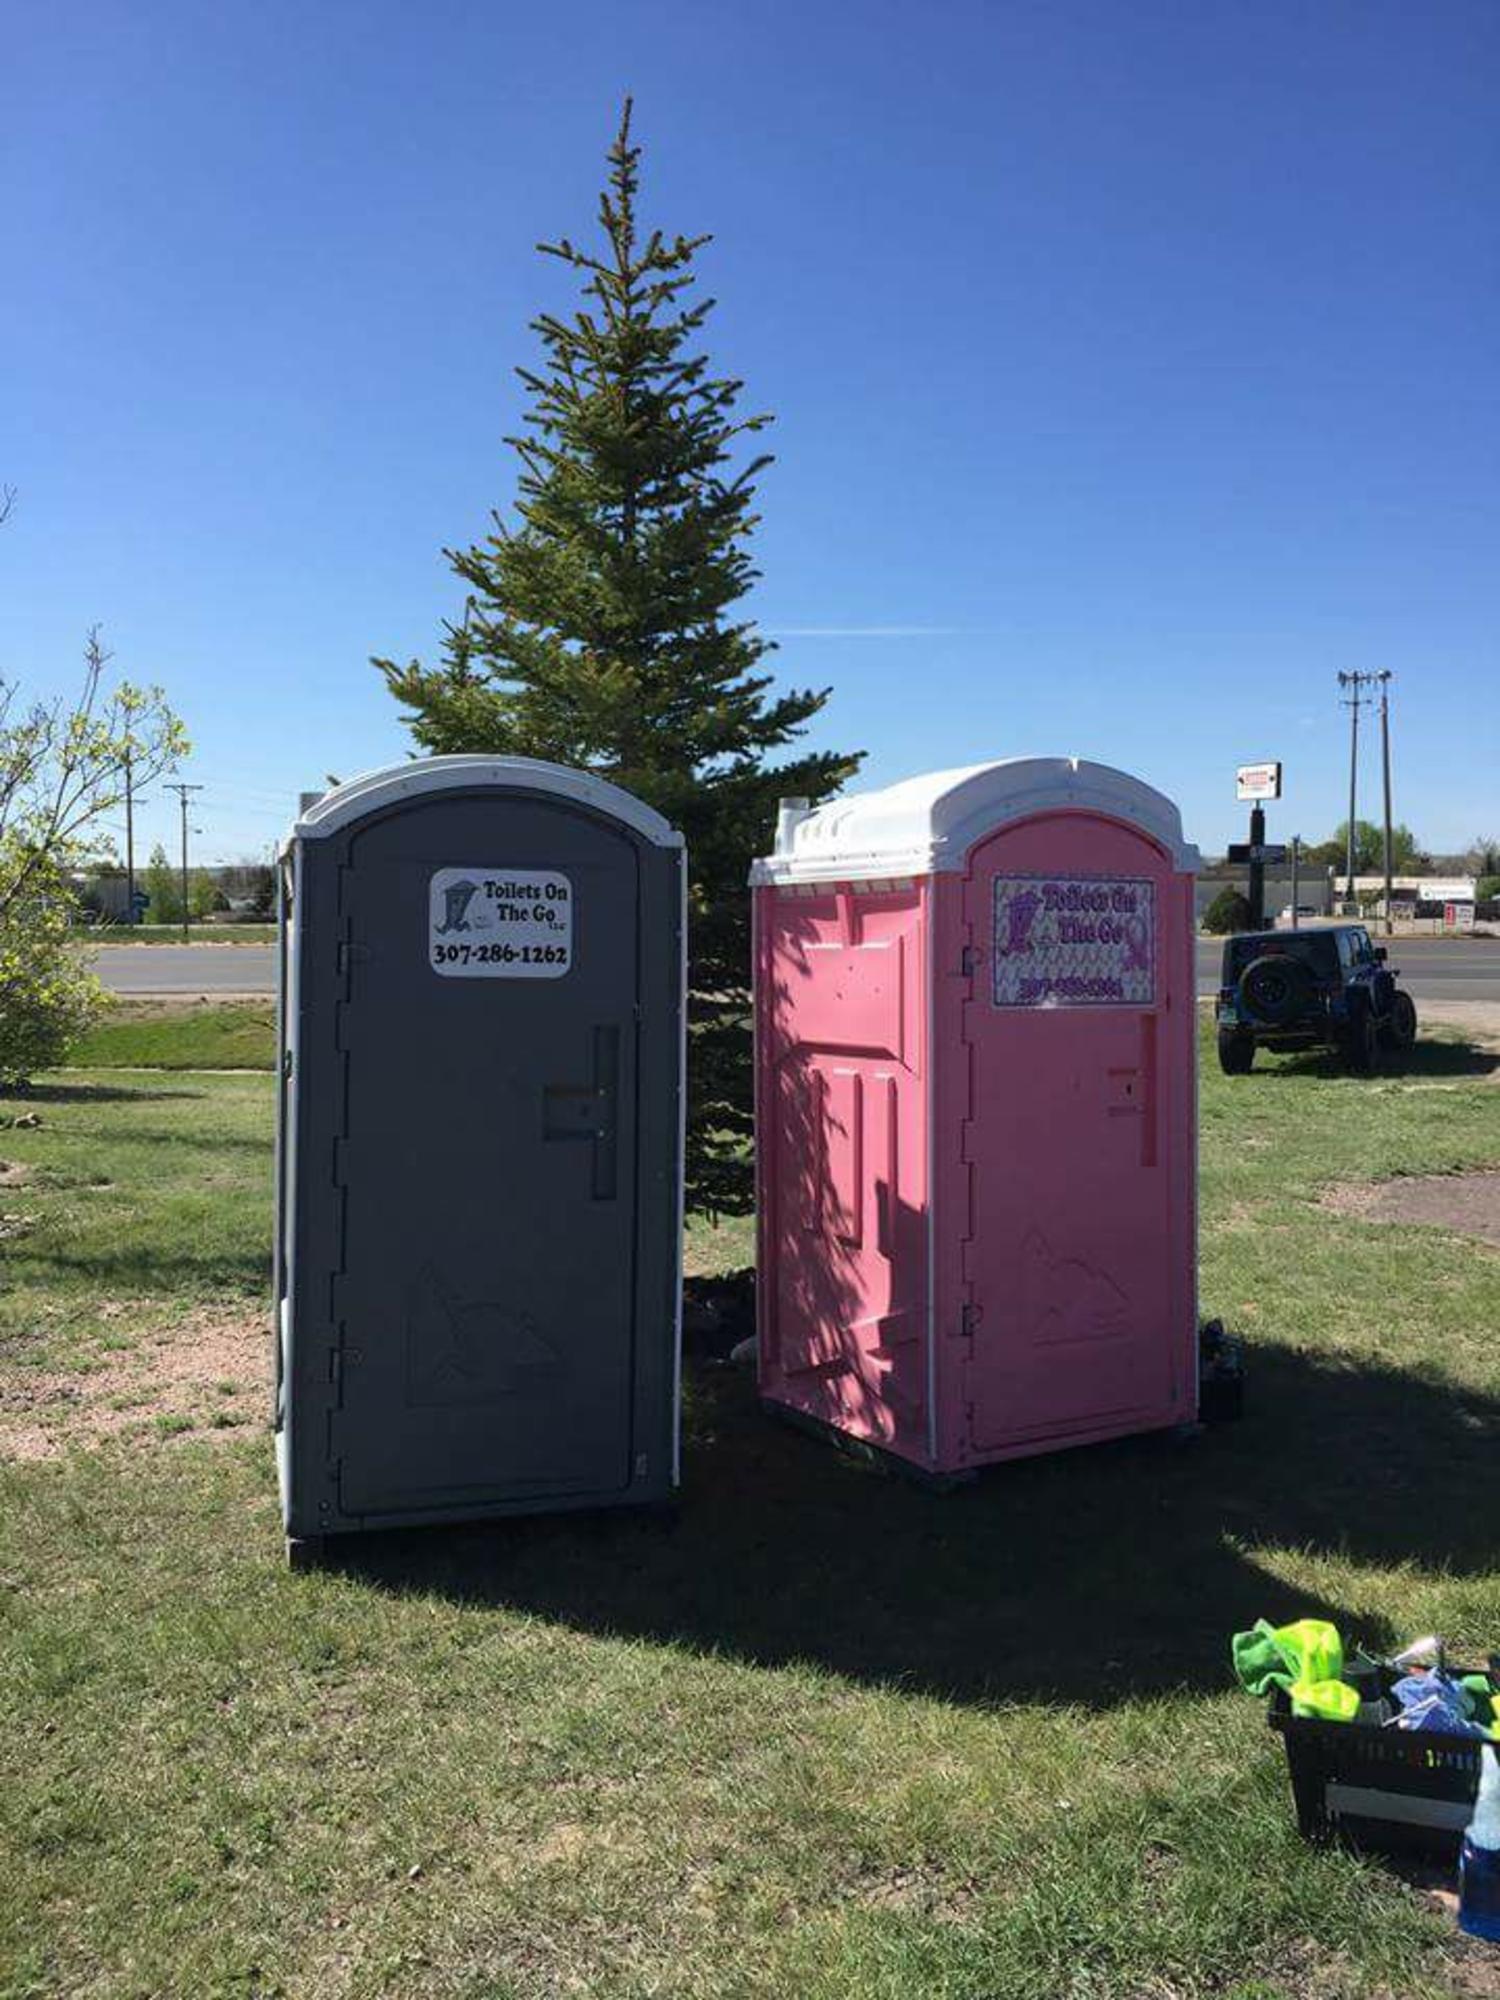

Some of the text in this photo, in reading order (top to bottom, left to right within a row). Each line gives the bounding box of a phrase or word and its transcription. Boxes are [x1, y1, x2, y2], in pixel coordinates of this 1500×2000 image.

[483, 881, 567, 901] Toilets On
[497, 903, 556, 922] The Go
[434, 943, 567, 965] 307-286-1262
